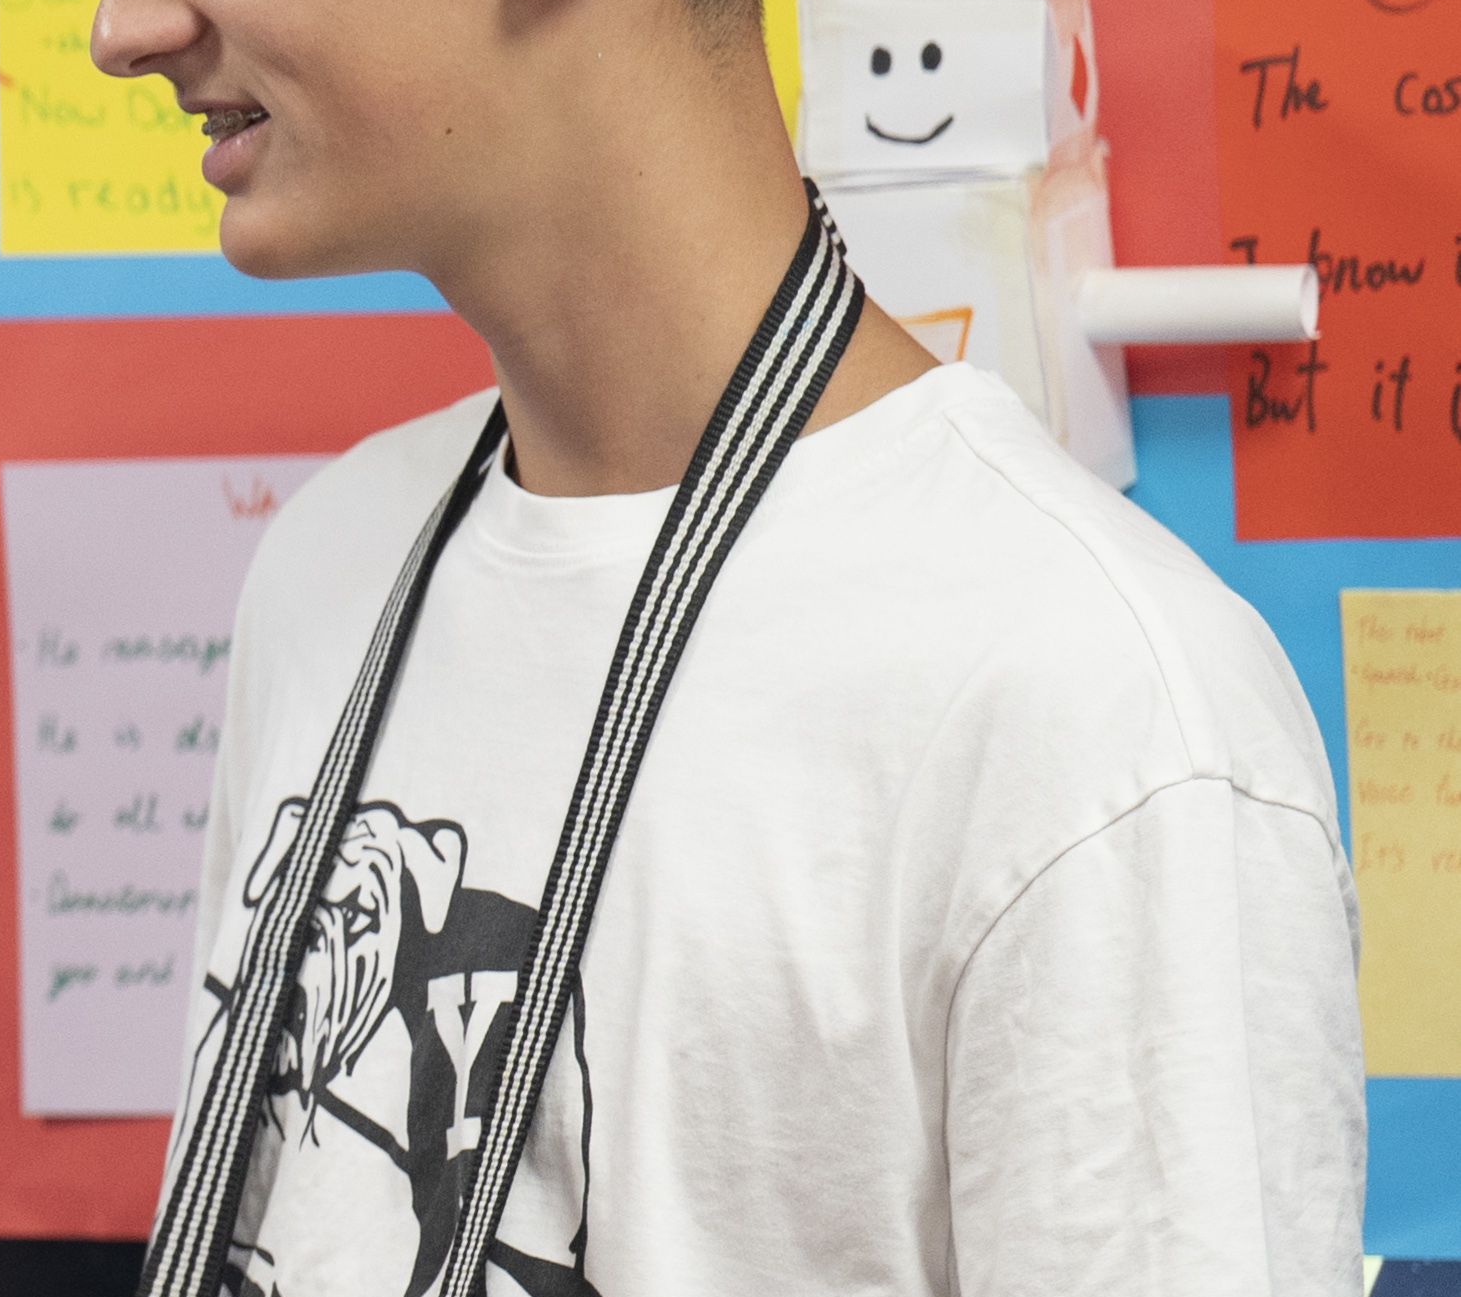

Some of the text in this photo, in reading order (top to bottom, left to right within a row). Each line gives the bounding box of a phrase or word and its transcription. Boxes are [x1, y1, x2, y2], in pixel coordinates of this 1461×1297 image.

[1238, 43, 1330, 130] The
[1308, 228, 1426, 304] know
[1244, 349, 1328, 434] But
